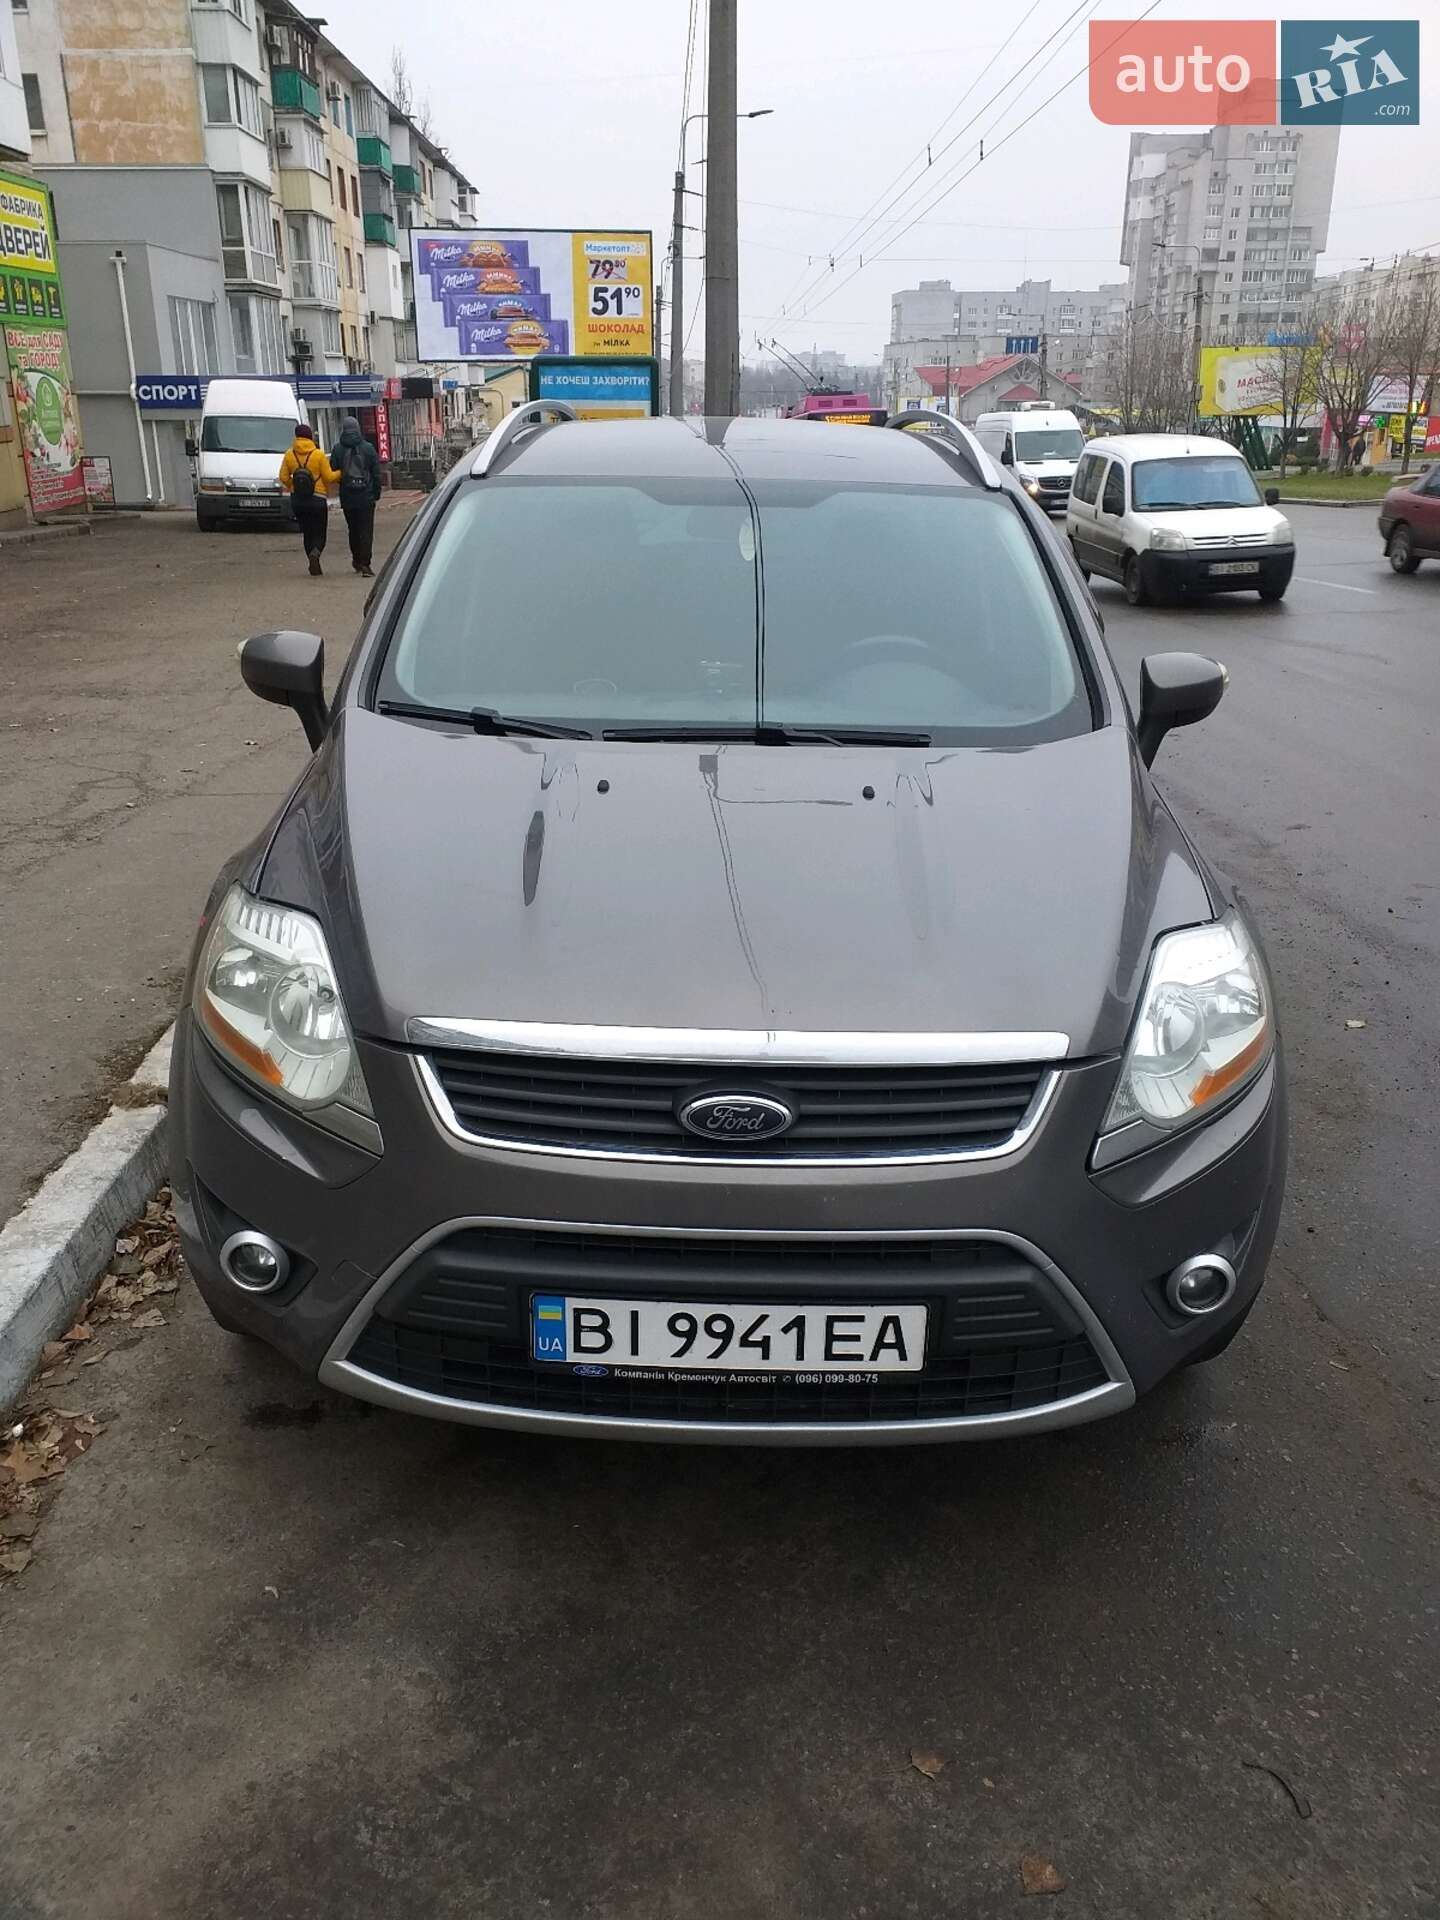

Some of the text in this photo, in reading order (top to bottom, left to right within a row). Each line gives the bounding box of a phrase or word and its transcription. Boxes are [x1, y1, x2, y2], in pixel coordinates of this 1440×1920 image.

[0, 193, 44, 220] ФАБРИКА
[430, 245, 462, 261] Milka
[443, 271, 475, 288] Milka
[457, 301, 488, 316] Milka
[591, 286, 624, 316] 51
[471, 326, 503, 342] Milka
[587, 323, 645, 335] ШОКОЛАД
[603, 339, 631, 347] МІЛКА
[540, 375, 650, 386] НЕ ХОЧЕШ ЗАХВОРІТИ?
[138, 384, 198, 401] СПОРТ
[377, 404, 389, 460] ОПТИКА
[706, 1105, 765, 1130] Ford
[538, 1337, 563, 1353] UA
[795, 1373, 823, 1385] (096)
